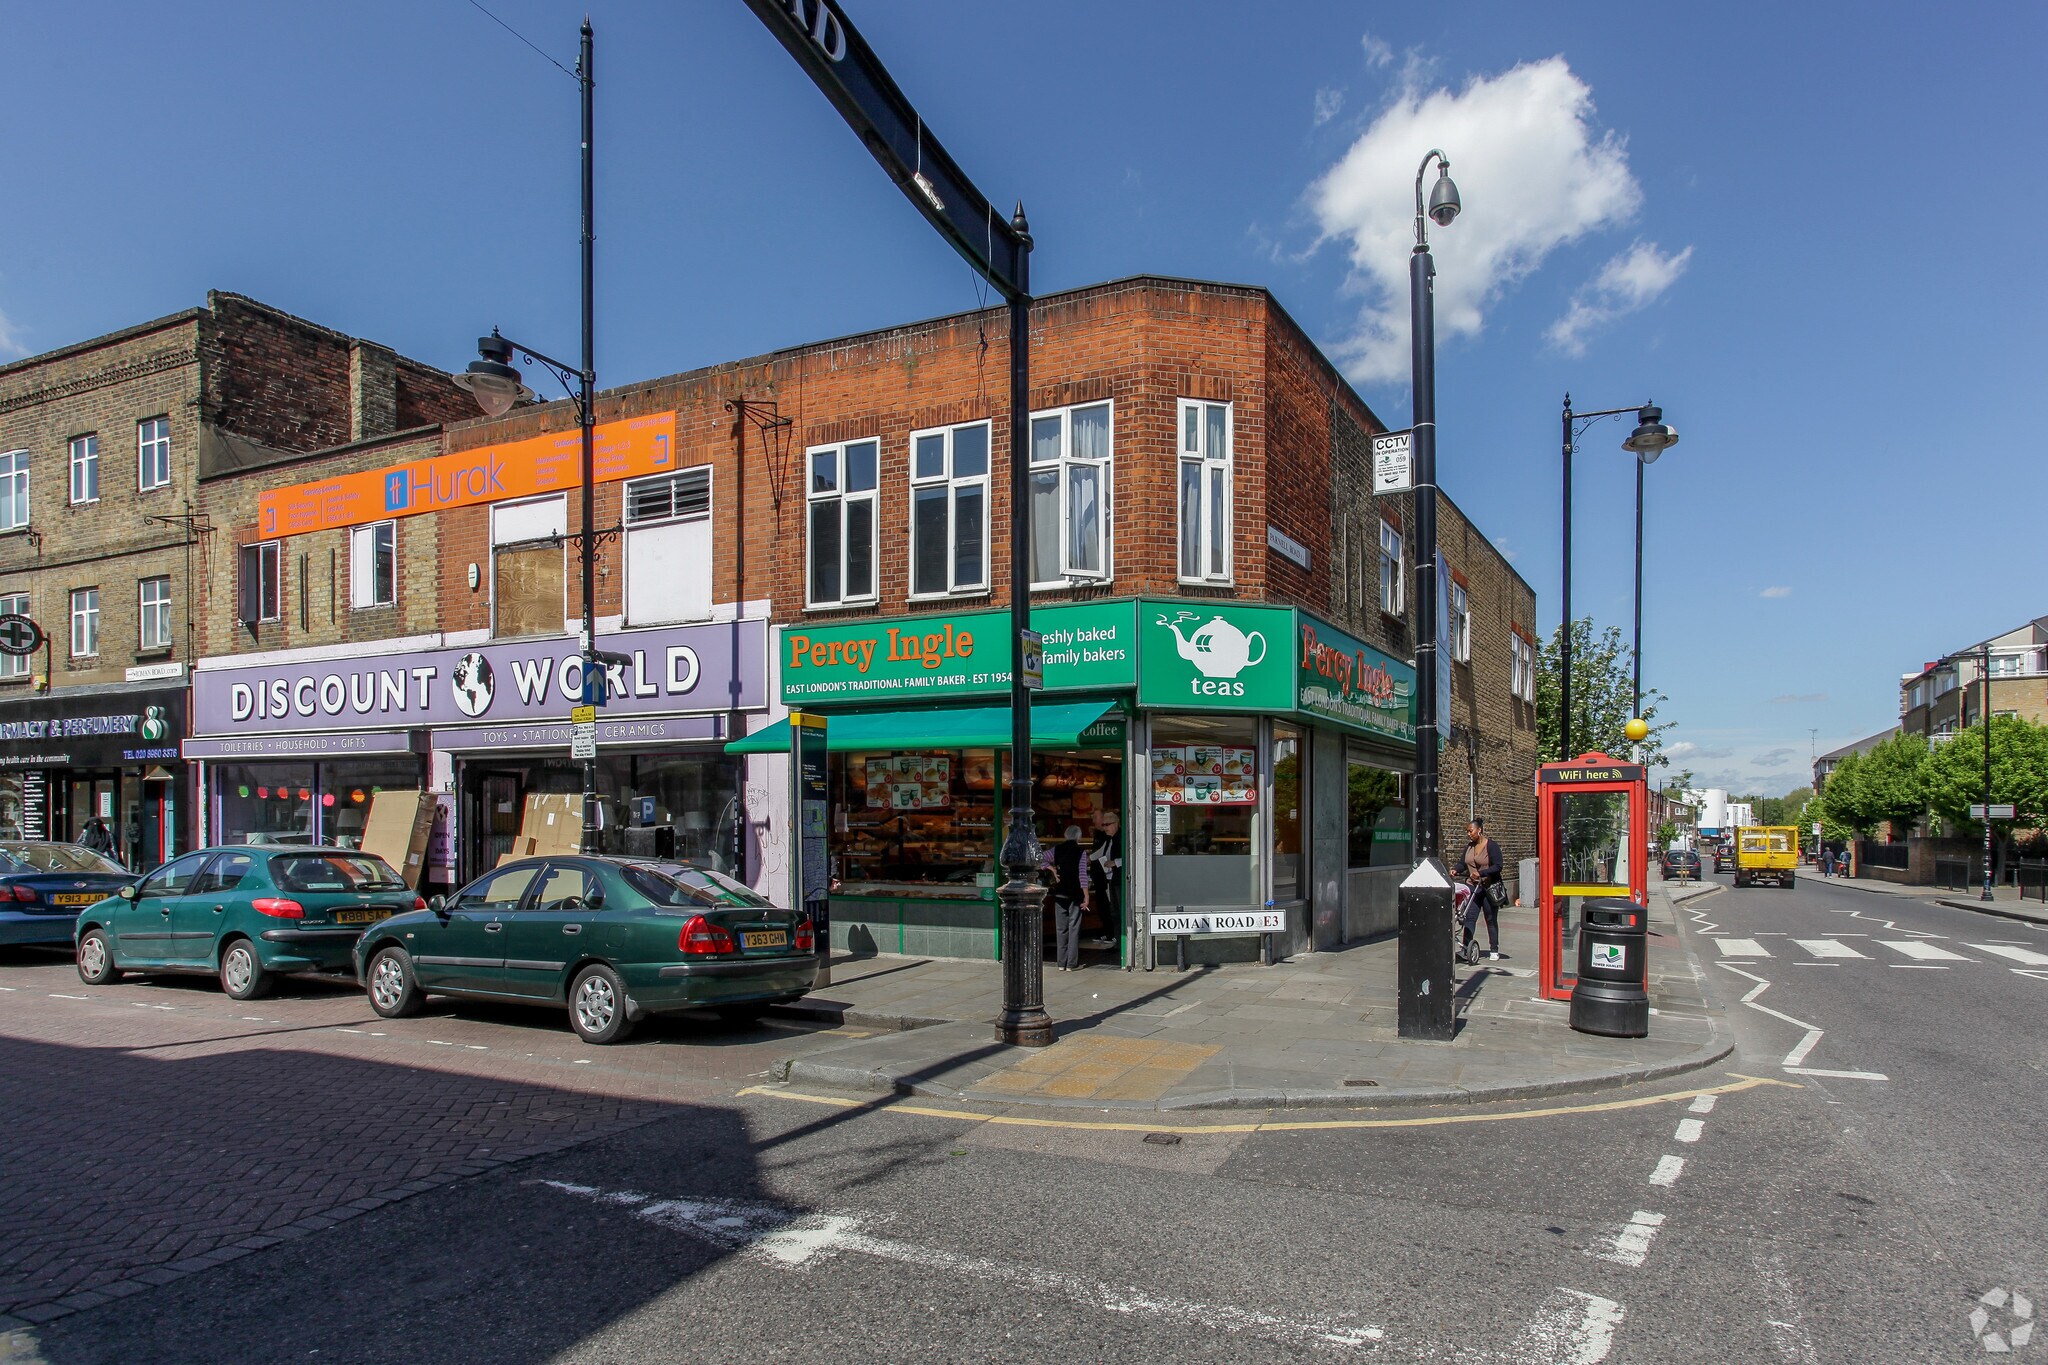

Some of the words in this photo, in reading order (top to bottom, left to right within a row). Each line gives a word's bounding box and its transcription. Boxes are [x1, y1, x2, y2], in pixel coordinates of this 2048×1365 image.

[1376, 436, 1408, 450] CCTV
[1382, 447, 1409, 456] OPERATION
[412, 453, 507, 507] Hurak
[1042, 629, 1074, 646] eshly
[1077, 625, 1116, 642] baked
[789, 635, 877, 673] Percy
[886, 623, 973, 669] Ingle
[1042, 649, 1080, 666] family
[1083, 646, 1125, 662] bakers
[1302, 624, 1353, 696] Percy
[1357, 650, 1393, 707] Ingle
[510, 645, 701, 706] WORLD
[786, 684, 805, 694] EAST
[806, 681, 847, 693] LONDON'S
[848, 678, 903, 691] TRADITIONAL
[904, 676, 936, 688] FAMILY
[937, 674, 966, 686] BAKER
[973, 673, 989, 684] EST
[991, 672, 1012, 683] 1954
[232, 666, 437, 721] DISCOUNT
[1191, 677, 1244, 696] teas
[1301, 687, 1314, 705] EAST
[1314, 692, 1341, 713] LONDON'S
[1341, 701, 1371, 724] TRADITIONAL
[0, 720, 48, 740] RMACY
[50, 720, 62, 737] &
[63, 715, 138, 736] PERFUMERY
[483, 731, 508, 743] TOYS
[522, 728, 575, 741] STATIONE
[605, 723, 666, 738] CERAMICS
[221, 741, 264, 752] TOILETRIES
[276, 739, 328, 750] HOUSEHOLD
[341, 737, 366, 748] GIFTS
[6, 755, 20, 764] health
[36, 755, 44, 763] the
[44, 753, 70, 764] community
[123, 750, 135, 759] TEL
[1559, 770, 1582, 780] WiFi
[1586, 769, 1609, 779] here
[643, 801, 654, 819] P
[1157, 917, 1210, 930] ROMAN
[1215, 916, 1254, 928] ROAD
[1263, 916, 1279, 927] E3
[745, 933, 769, 946] Y363
[769, 931, 786, 944] GHW
